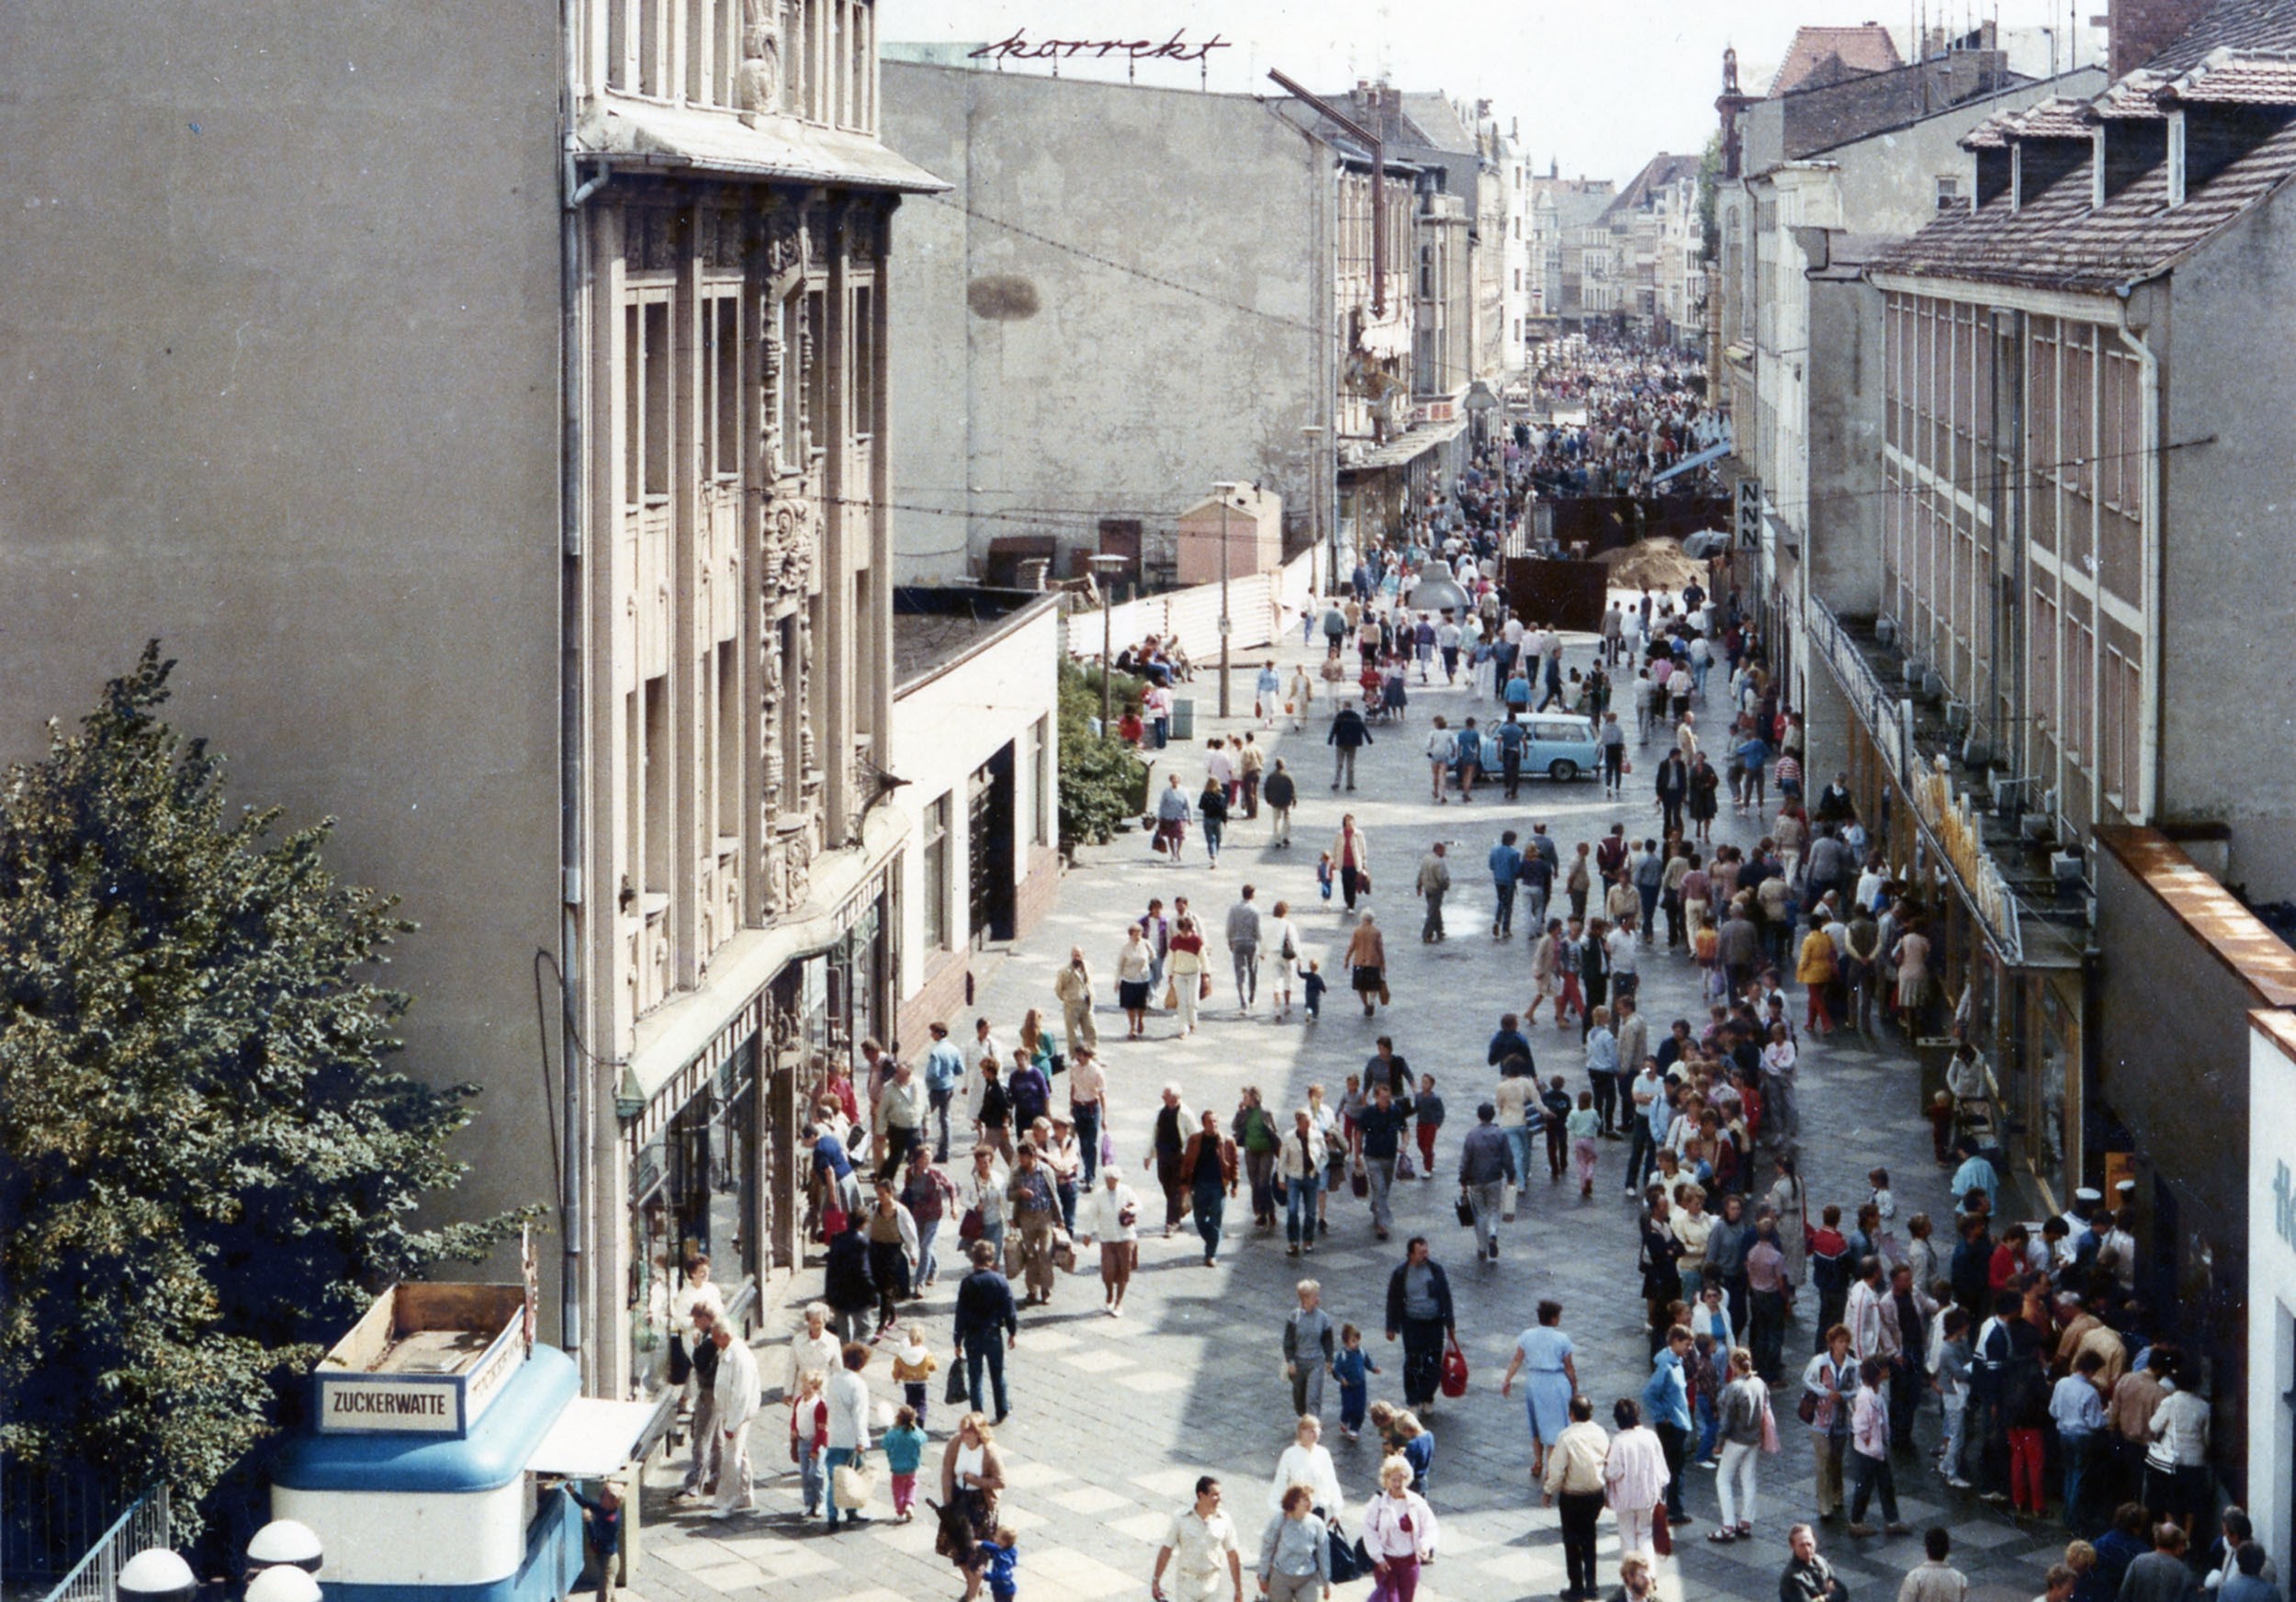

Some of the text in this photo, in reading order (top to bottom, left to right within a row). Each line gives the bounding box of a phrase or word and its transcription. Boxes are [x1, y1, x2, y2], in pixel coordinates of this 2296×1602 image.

[967, 28, 1232, 61] korrekt
[1741, 484, 1758, 547] NNN
[333, 1392, 445, 1415] ZUCKERWATTE
